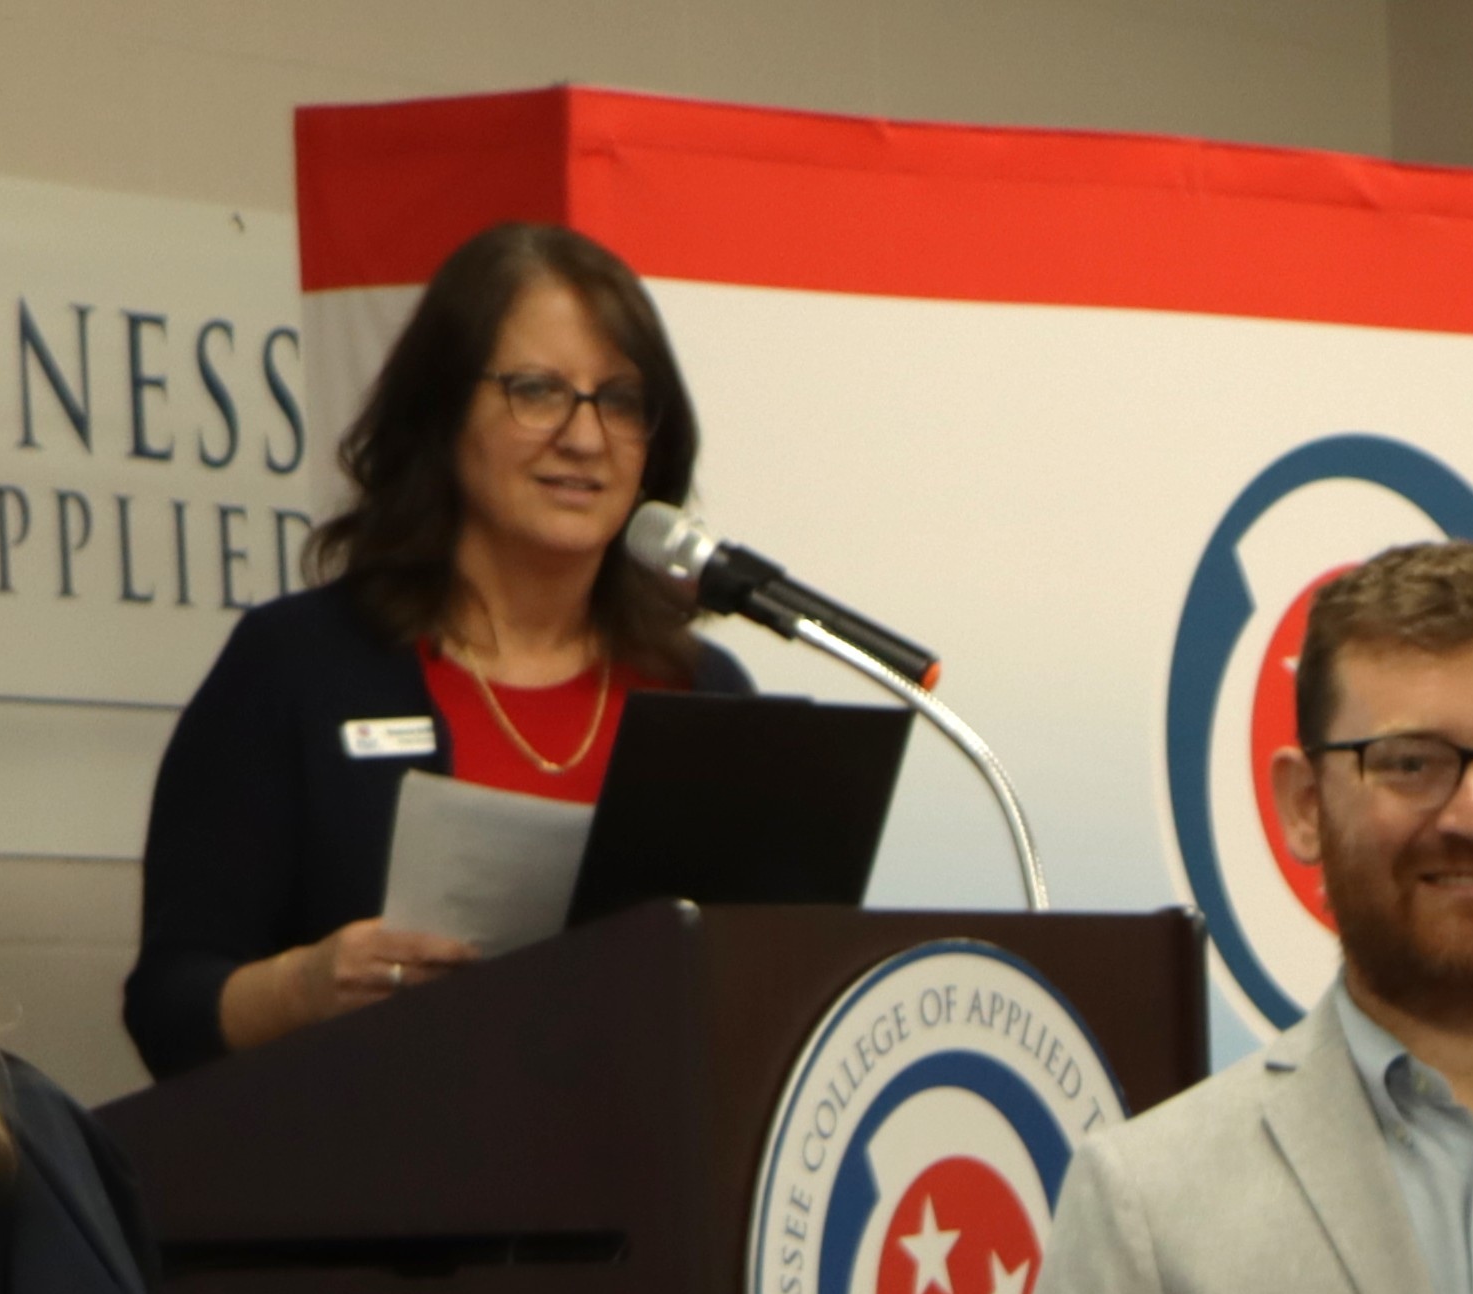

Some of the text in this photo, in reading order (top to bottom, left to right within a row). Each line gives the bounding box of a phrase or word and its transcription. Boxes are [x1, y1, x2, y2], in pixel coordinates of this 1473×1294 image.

[802, 1002, 911, 1174] COLLEGE
[919, 985, 957, 1029] OF
[966, 985, 1084, 1101] APPLIED
